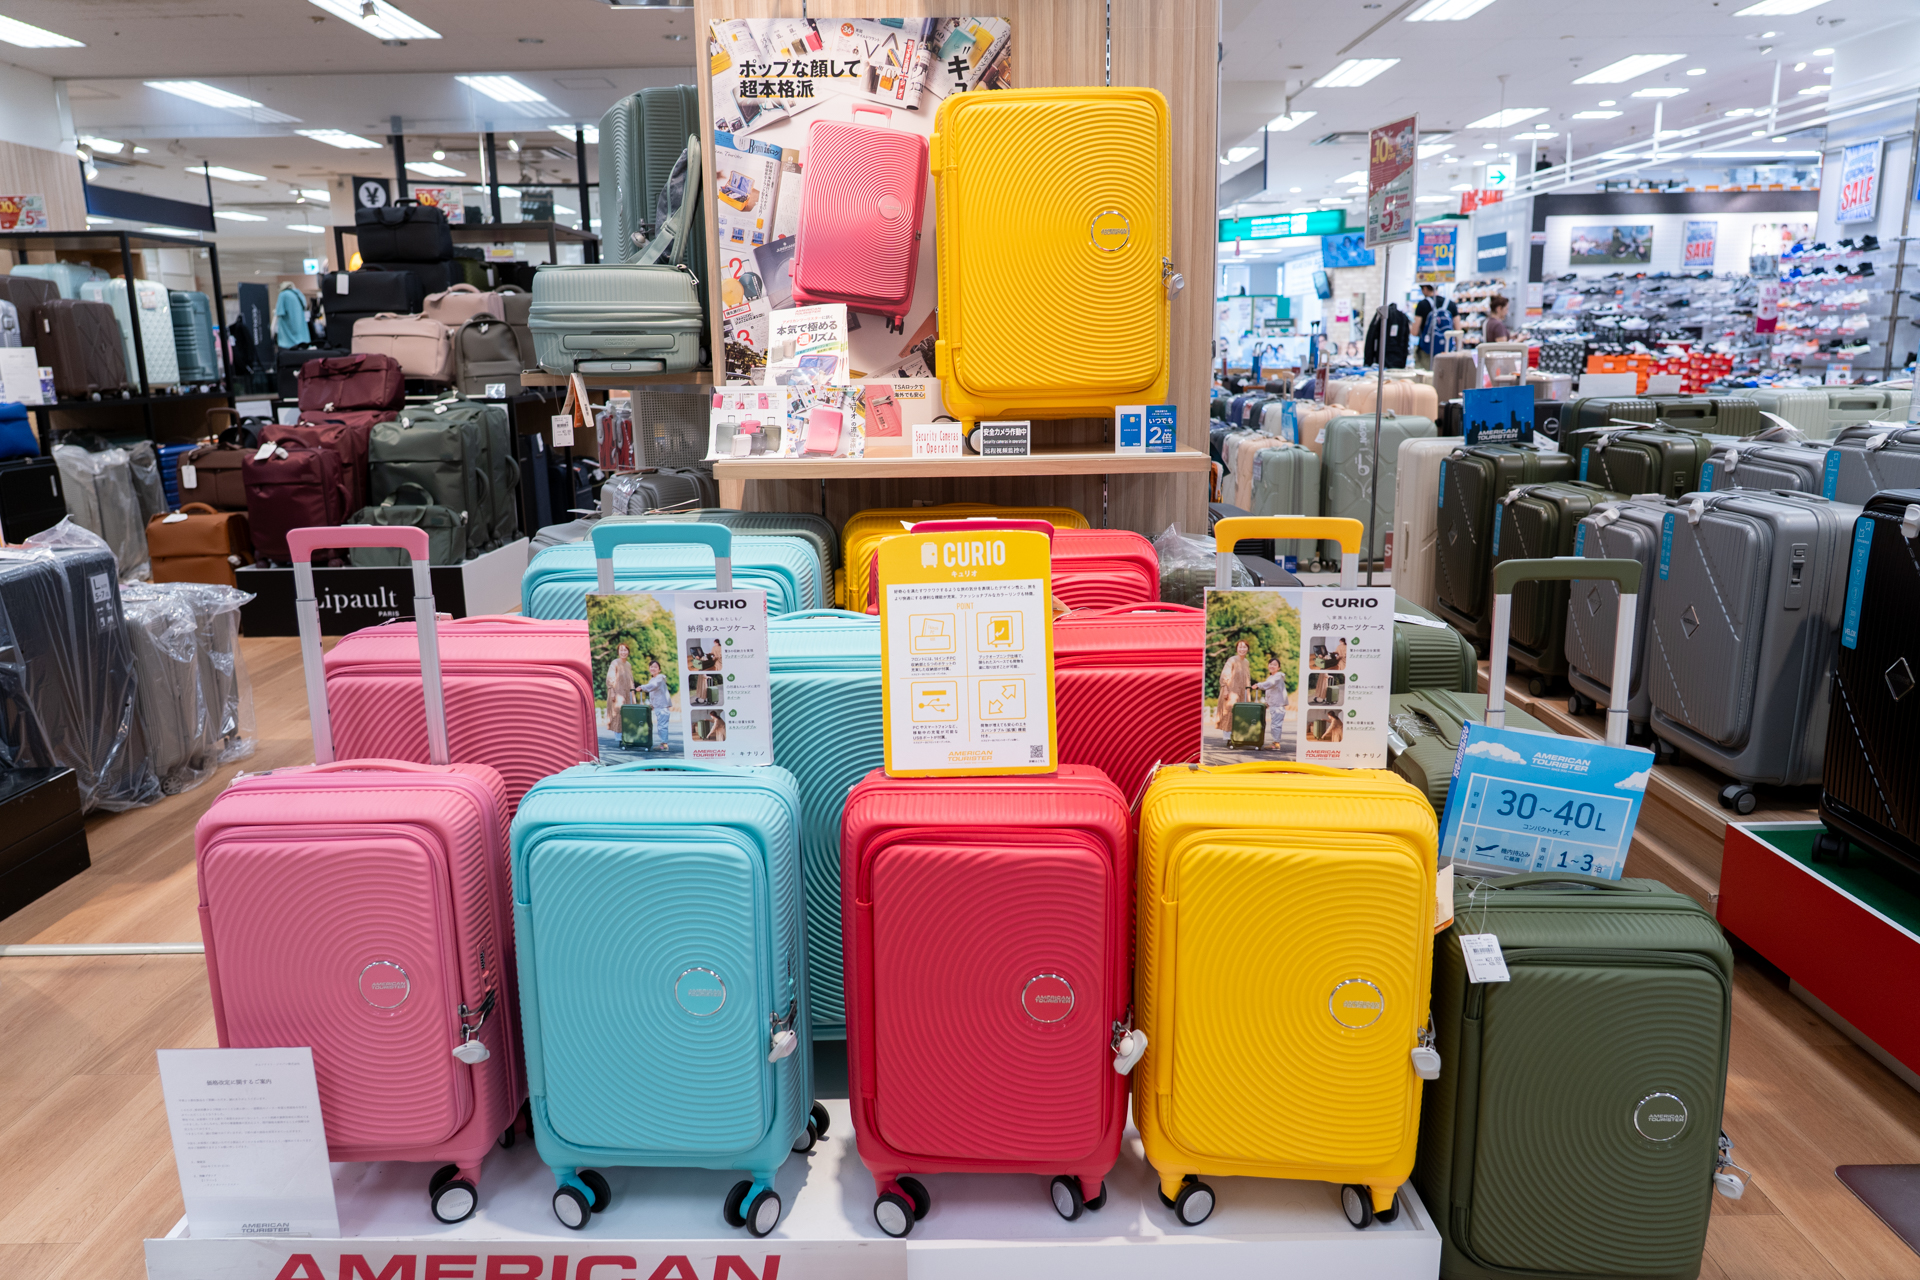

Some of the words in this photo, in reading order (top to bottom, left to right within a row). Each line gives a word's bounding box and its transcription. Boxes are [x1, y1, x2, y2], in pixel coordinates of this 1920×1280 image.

[739, 59, 861, 77] ポップな顔して
[740, 80, 814, 98] 超本格派
[1841, 175, 1873, 211] SALE
[26, 210, 34, 225] 5
[1381, 195, 1395, 232] 5
[1686, 240, 1714, 260] SALE
[729, 258, 743, 279] 2
[777, 321, 837, 335] 本気で極める
[916, 431, 937, 442] Security
[940, 431, 958, 441] Cameras
[1149, 426, 1172, 444] 2倍
[916, 444, 922, 454] in
[926, 442, 958, 454] Operation
[943, 540, 1006, 568] CURIO
[694, 599, 747, 609] CURIO
[1322, 598, 1378, 608] CURIO
[1532, 758, 1589, 773] TOURISTER
[1533, 751, 1591, 766] AMERICAN
[1470, 791, 1479, 809] 容量
[1522, 823, 1570, 837] コンパクトサイズ
[1500, 848, 1531, 858] 機内持込み
[273, 1253, 782, 1280] AMERICAN
